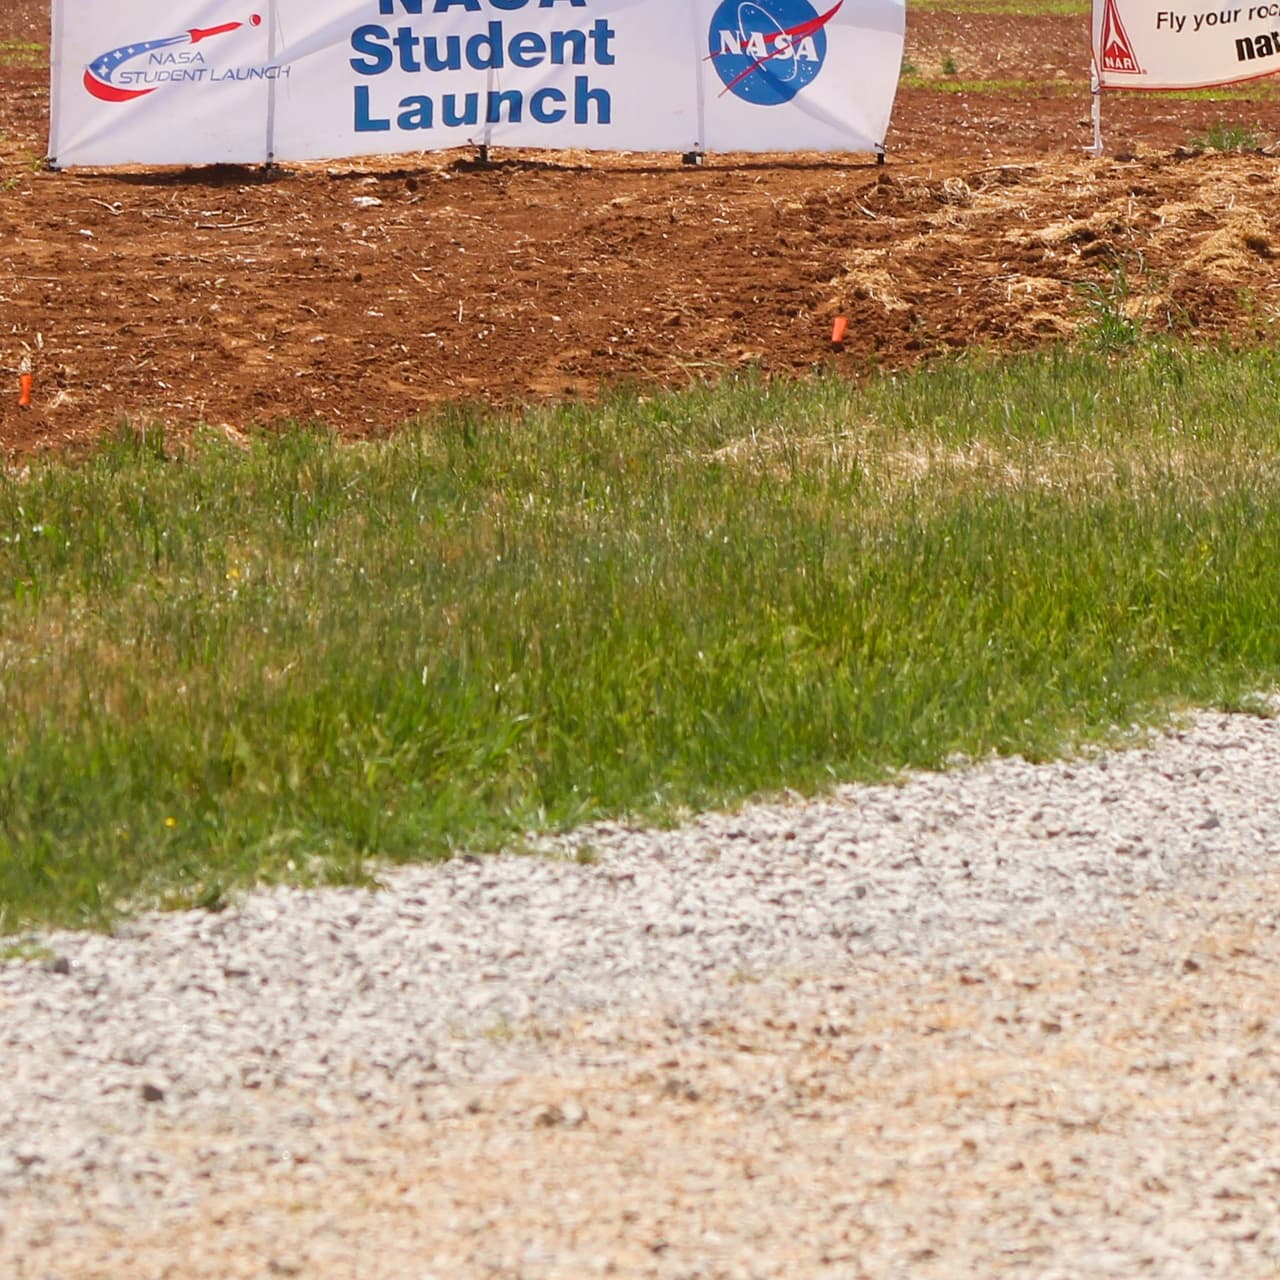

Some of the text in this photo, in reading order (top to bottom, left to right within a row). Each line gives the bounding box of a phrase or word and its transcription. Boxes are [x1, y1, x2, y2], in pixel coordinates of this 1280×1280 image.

[1156, 11, 1186, 33] Fly
[1193, 7, 1242, 31] your
[148, 51, 205, 65] NASA
[349, 19, 616, 76] Student
[718, 30, 820, 62] NASA
[118, 65, 291, 84] STUDENT LAUNCH
[1105, 56, 1134, 69] NAR
[354, 75, 612, 132] Launch
